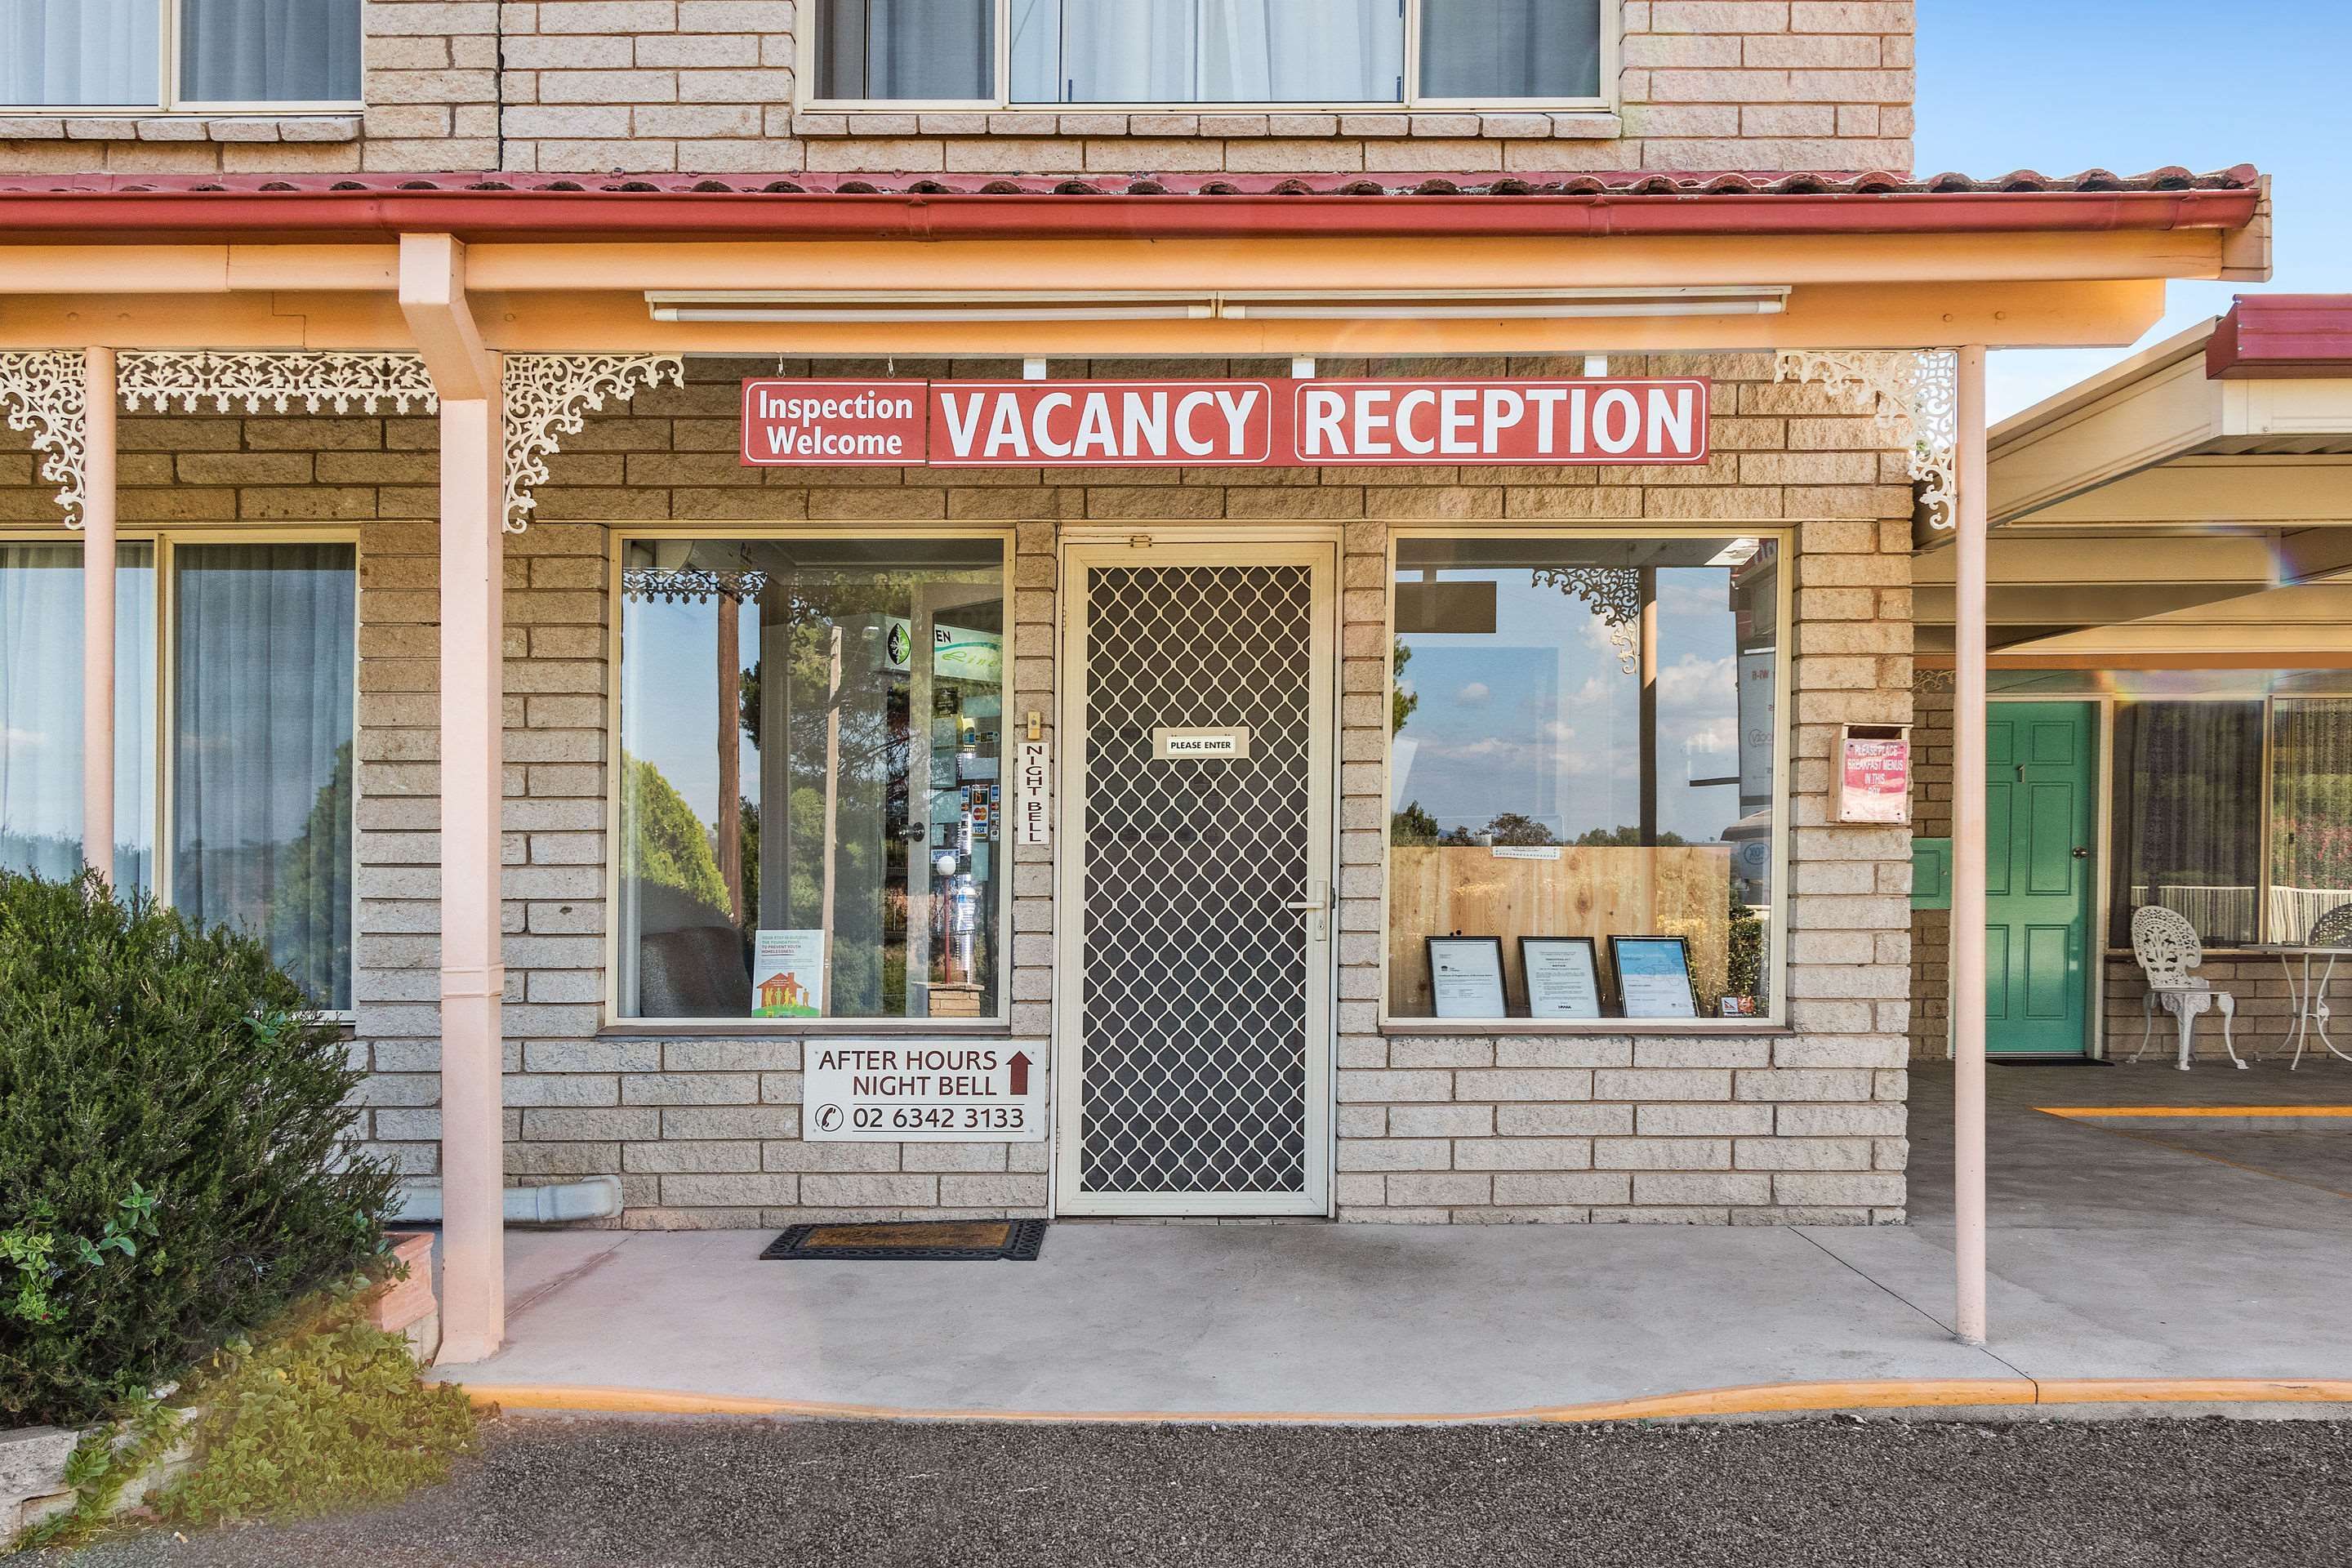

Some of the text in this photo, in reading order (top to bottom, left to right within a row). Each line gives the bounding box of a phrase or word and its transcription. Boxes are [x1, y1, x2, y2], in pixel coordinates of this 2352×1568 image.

[759, 390, 913, 428] Inspection
[939, 387, 1694, 458] VACANCY RECEPTION
[765, 425, 903, 456] Welcome
[934, 630, 952, 644] EN
[1855, 744, 1898, 756] PLEASE PLACE
[1026, 746, 1043, 796] NIGHT
[1847, 759, 1904, 771] BREAKFAST MENUS
[2017, 764, 2025, 784] 1
[1864, 773, 1886, 785] IN THIS
[1027, 802, 1042, 842] BELL
[818, 1050, 998, 1071] AFTER HOURS
[853, 1076, 997, 1096] NIGHT BELL
[853, 1107, 1024, 1129] 02 6342 3133
